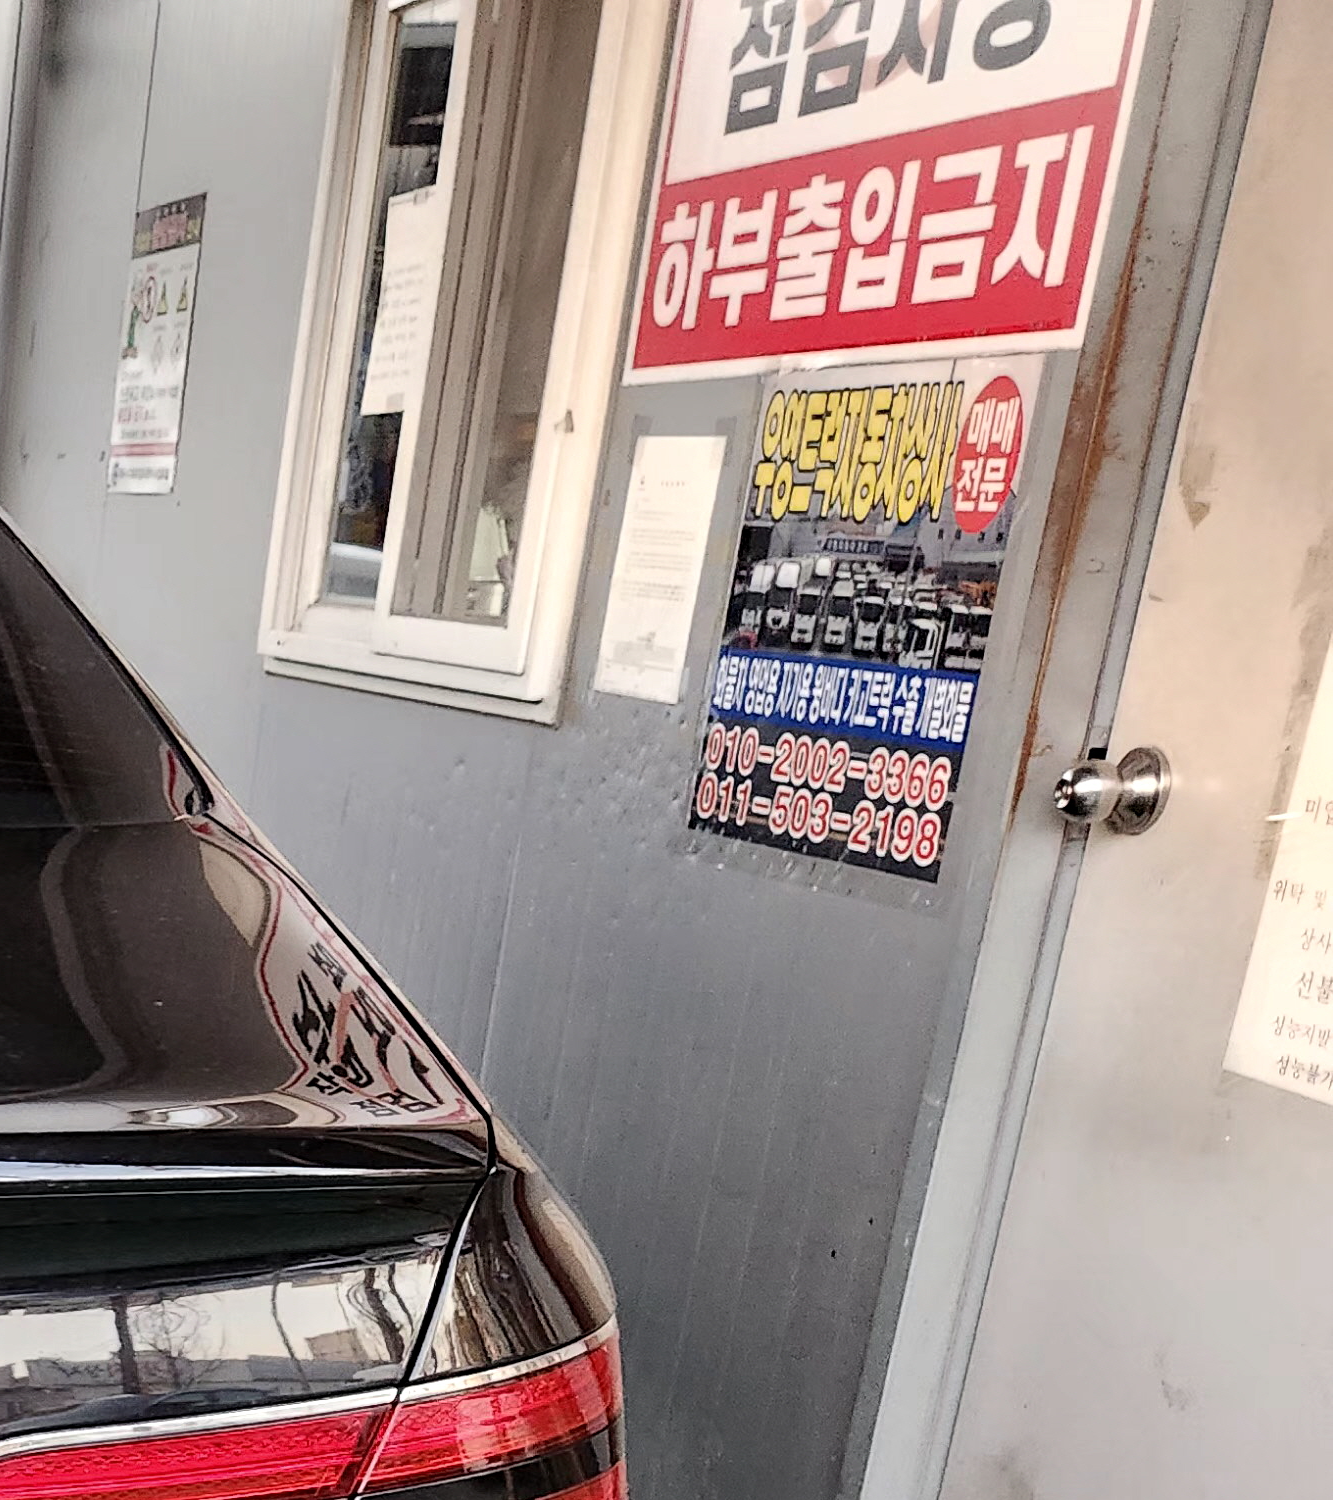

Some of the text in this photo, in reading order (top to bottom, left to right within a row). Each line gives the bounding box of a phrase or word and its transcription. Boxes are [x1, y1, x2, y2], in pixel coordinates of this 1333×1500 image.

[652, 126, 1095, 330] 하부출입금지
[966, 396, 1021, 454] 매매
[955, 456, 1008, 513] 전문
[713, 654, 749, 711] 화물차
[744, 658, 781, 718] 영업용
[776, 661, 814, 722] 자가용
[843, 669, 896, 732] 카고트럭
[892, 675, 922, 735] 수출
[915, 677, 974, 743] 개별화물
[706, 722, 951, 811] 010-2002-3366
[697, 772, 941, 868] 011-503-2198
